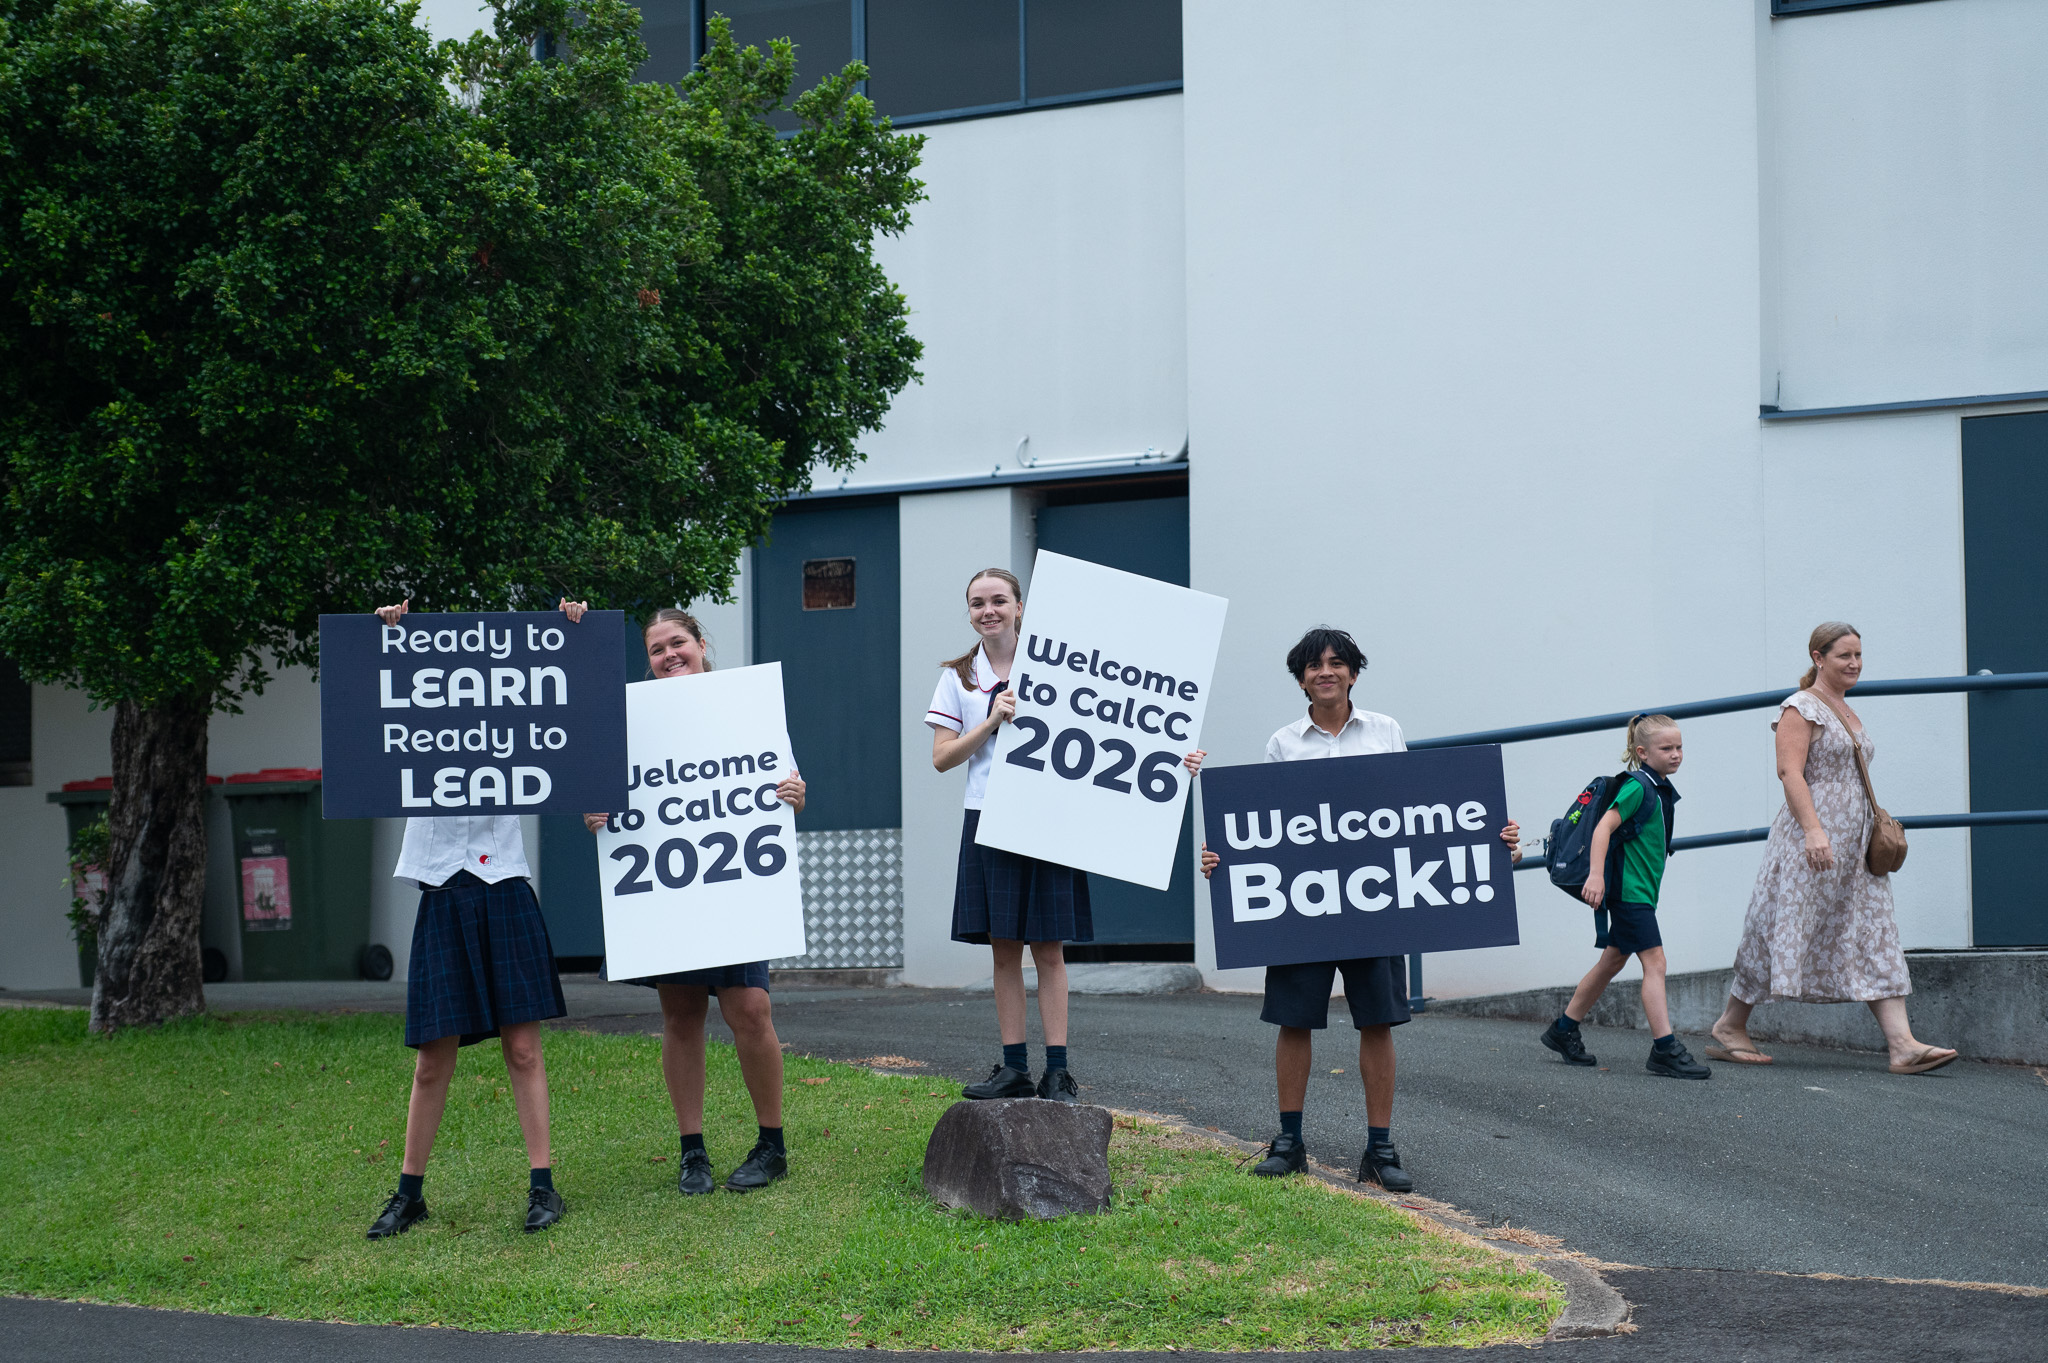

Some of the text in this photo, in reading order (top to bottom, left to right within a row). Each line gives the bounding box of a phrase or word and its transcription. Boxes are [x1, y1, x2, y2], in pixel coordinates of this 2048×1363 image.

[382, 622, 564, 659] Ready to
[1028, 634, 1198, 701] Welcome
[1018, 673, 1192, 741] to CalCC
[384, 721, 567, 758] Ready to
[1005, 716, 1182, 802] 2026
[401, 767, 551, 807] LEAD
[658, 783, 782, 825] CalCC
[1225, 801, 1487, 850] Welcome
[610, 825, 786, 896] 2026
[1229, 844, 1494, 922] Back!!
